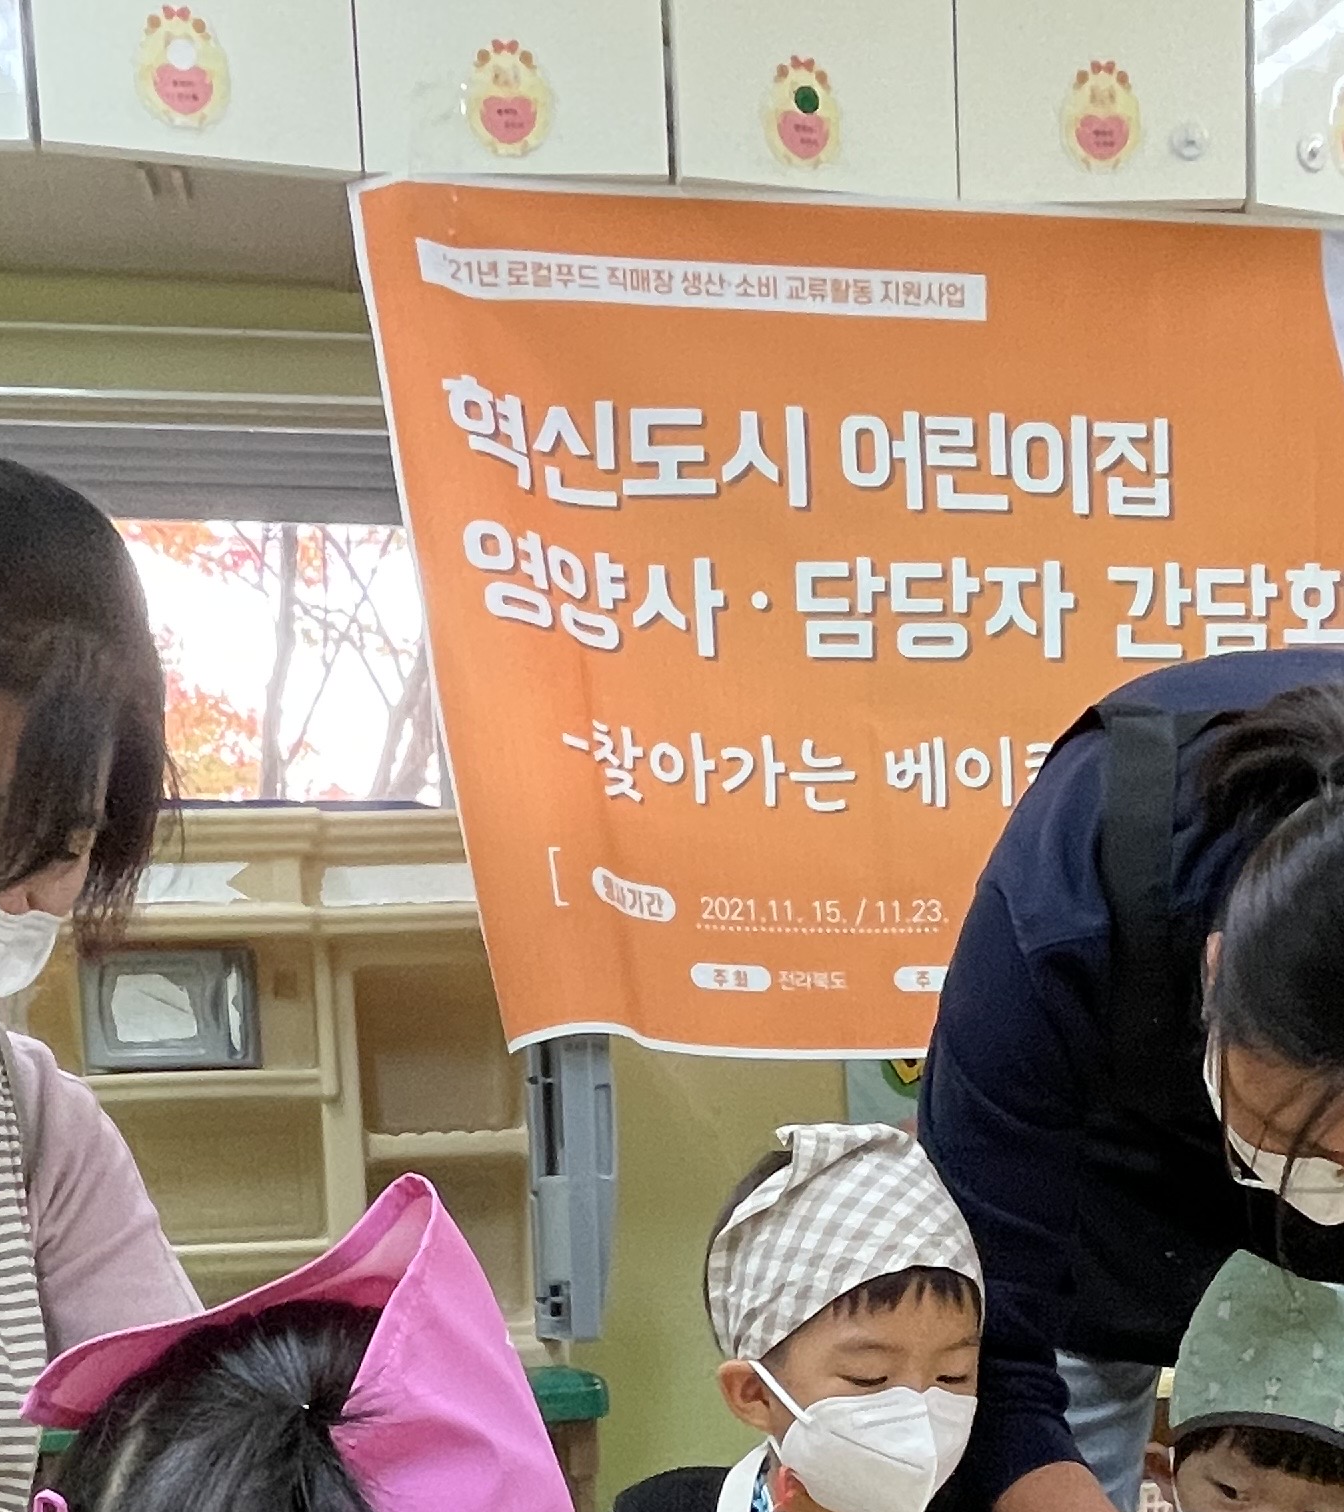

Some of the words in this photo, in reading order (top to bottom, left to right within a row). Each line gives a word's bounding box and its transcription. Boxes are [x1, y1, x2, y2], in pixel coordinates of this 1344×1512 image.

[507, 260, 600, 289] 로컬푸드
[606, 266, 673, 294] 직매장
[785, 276, 873, 305] 교류활동
[880, 279, 966, 308] 지원사업
[442, 374, 808, 508] 혁신도시
[841, 411, 1170, 517] 어린이집
[778, 969, 848, 991] 전라북도
